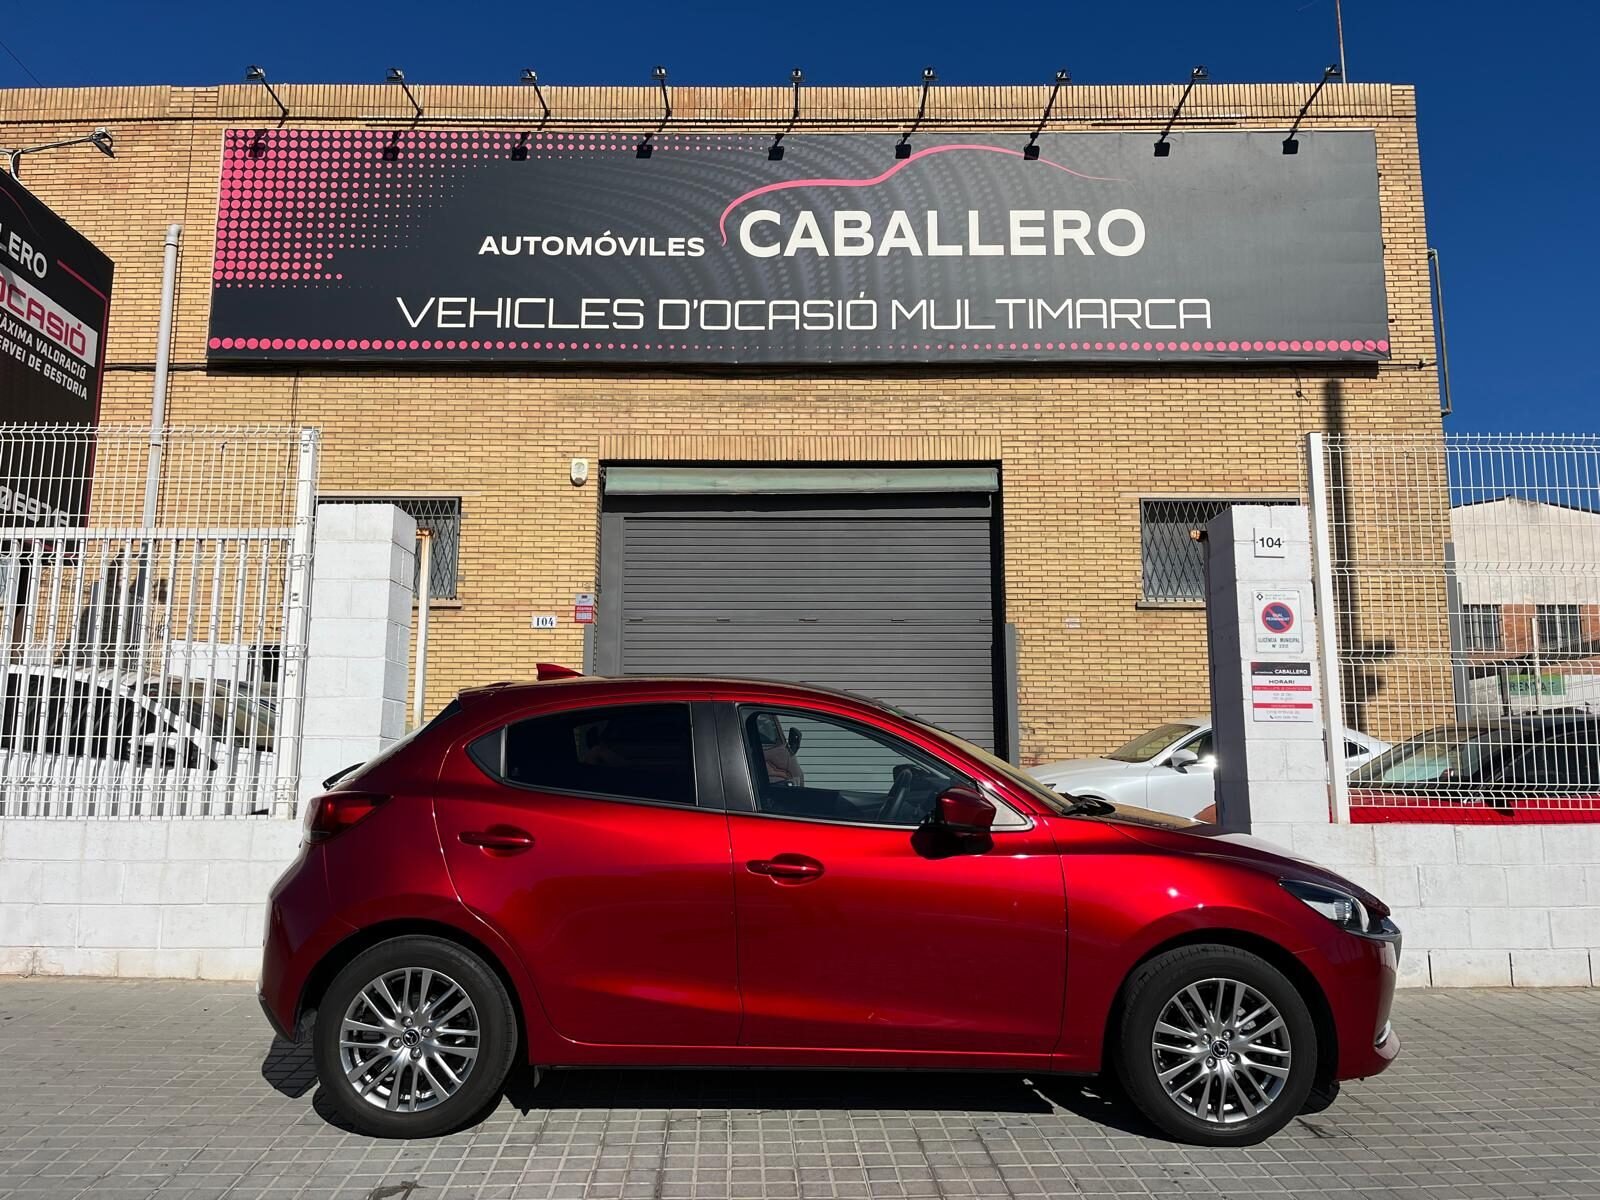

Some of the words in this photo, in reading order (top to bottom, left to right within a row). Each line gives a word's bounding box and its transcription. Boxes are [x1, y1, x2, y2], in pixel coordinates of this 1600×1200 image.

[478, 230, 705, 257] AUTOMÓVILES
[739, 208, 1146, 258] CABALLERO
[396, 297, 645, 330] VEHICLES
[658, 291, 877, 331] D'OCASIÓ
[891, 298, 1212, 330] MULTIMARCA
[28, 353, 42, 372] DE
[43, 363, 87, 401] GESTORIA
[36, 337, 87, 380] VALORACIÓ
[536, 617, 554, 627] 104
